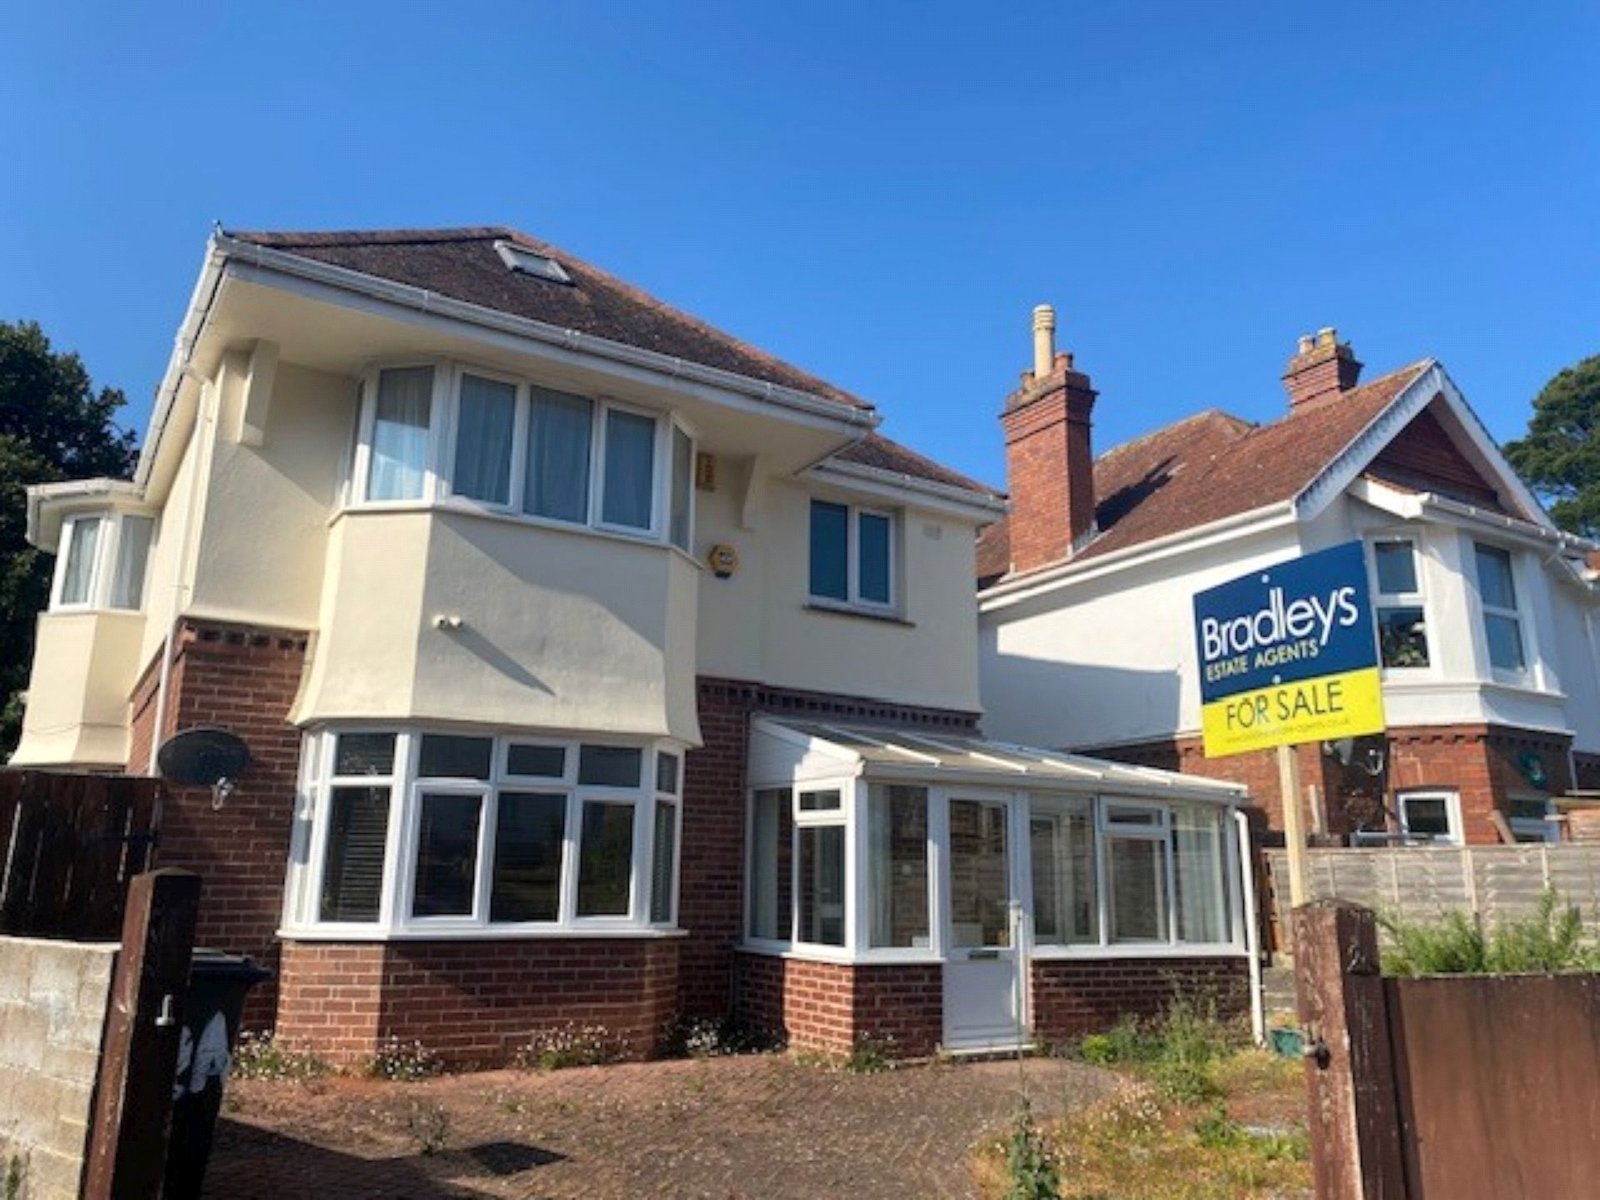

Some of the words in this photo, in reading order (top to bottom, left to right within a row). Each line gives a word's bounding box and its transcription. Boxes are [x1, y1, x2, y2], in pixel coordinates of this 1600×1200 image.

[1202, 587, 1358, 660] Bradleys
[1207, 656, 1248, 681] ESTATE
[1254, 639, 1318, 667] AGENTS
[1226, 695, 1268, 730] FOR
[1277, 681, 1343, 720] SALE
